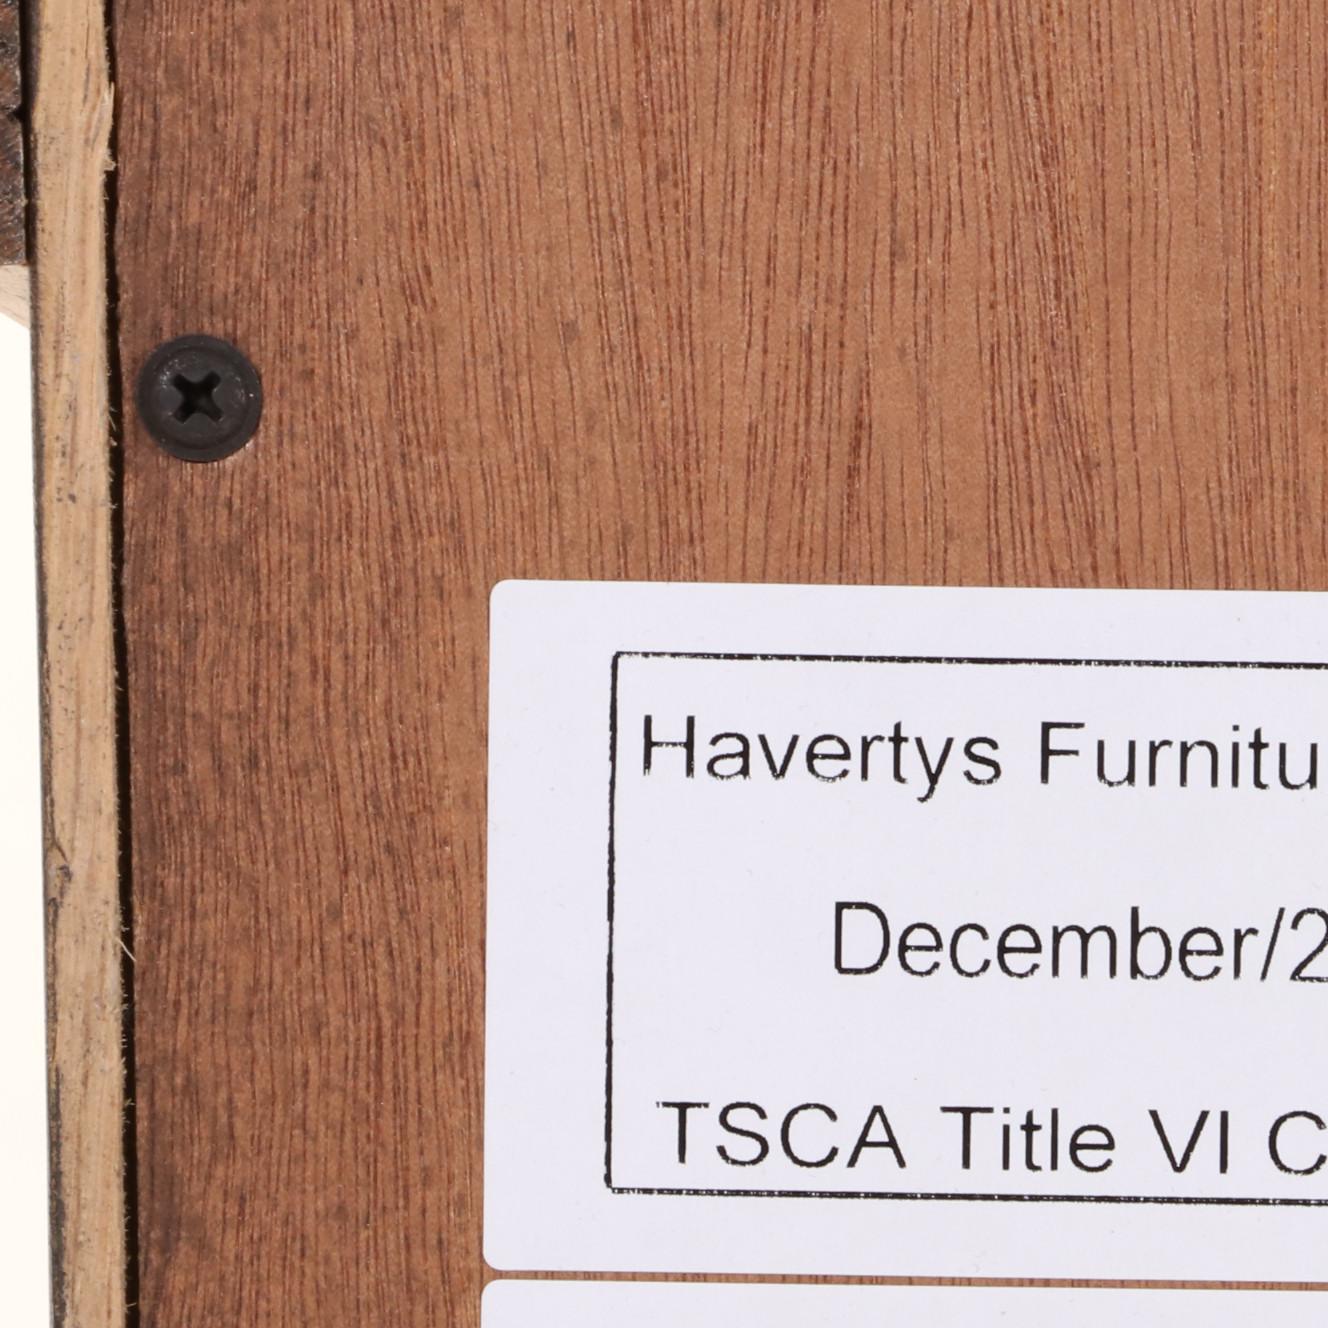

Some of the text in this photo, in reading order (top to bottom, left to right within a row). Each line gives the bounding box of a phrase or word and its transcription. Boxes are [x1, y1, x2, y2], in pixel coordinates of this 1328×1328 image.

[644, 715, 1001, 803] Havertys
[656, 1102, 906, 1168] TSCA
[940, 1107, 1115, 1172] Title
[1149, 1110, 1228, 1174] VI
